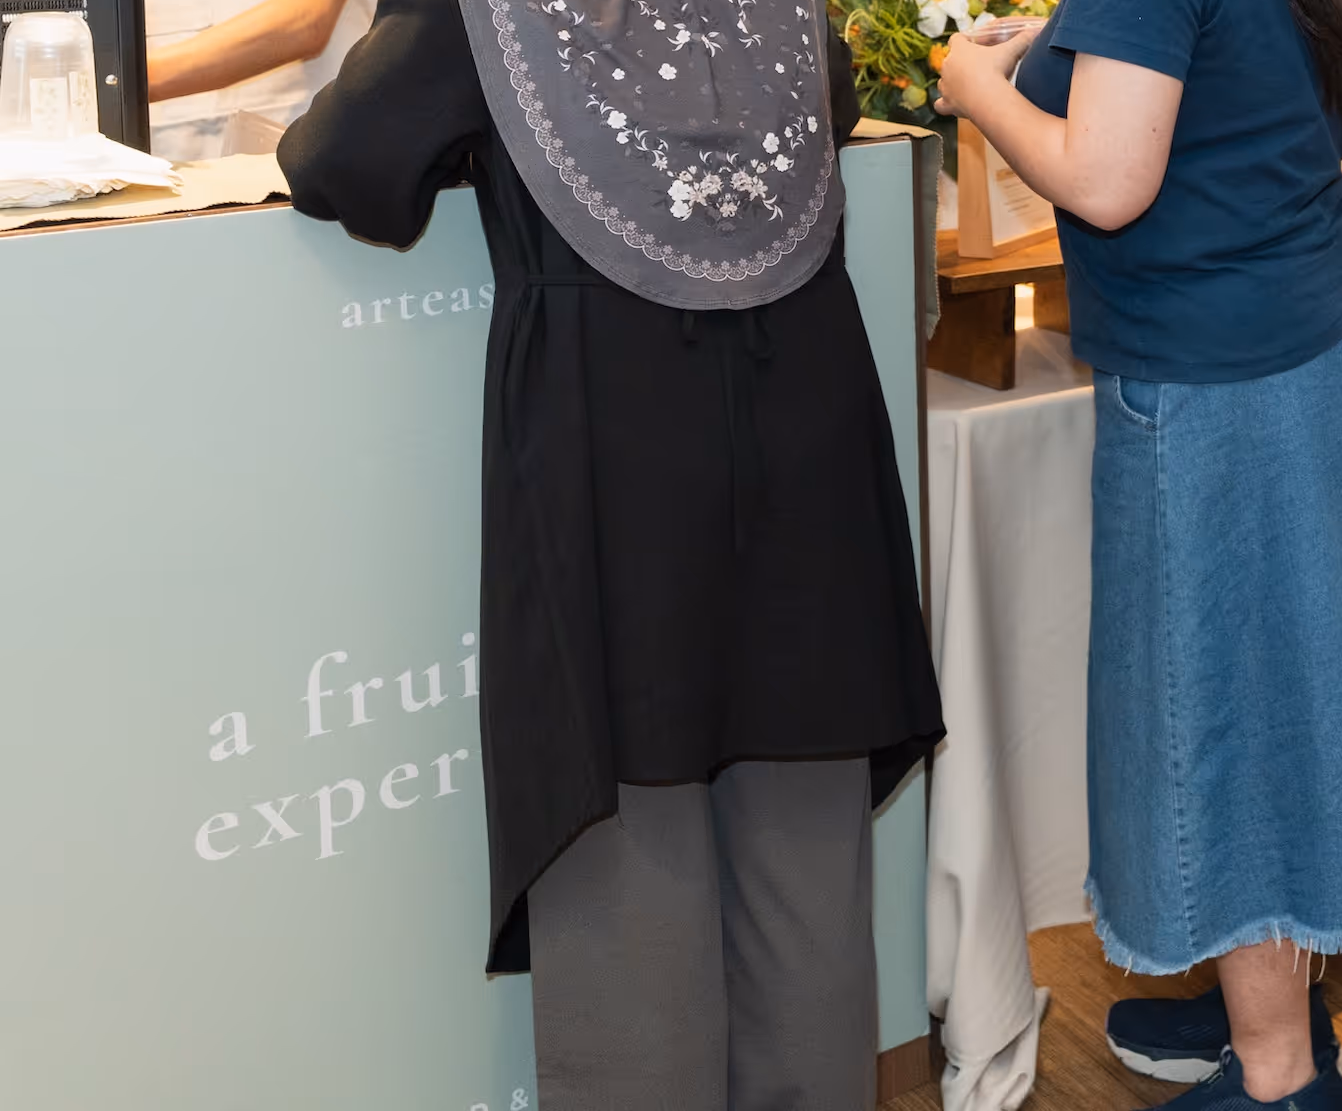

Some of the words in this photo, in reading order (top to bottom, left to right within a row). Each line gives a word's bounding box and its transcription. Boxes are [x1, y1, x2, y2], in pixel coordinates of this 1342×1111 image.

[341, 283, 496, 329] arteas
[208, 711, 256, 762] a
[300, 631, 480, 738] frui
[194, 748, 481, 861] exper
